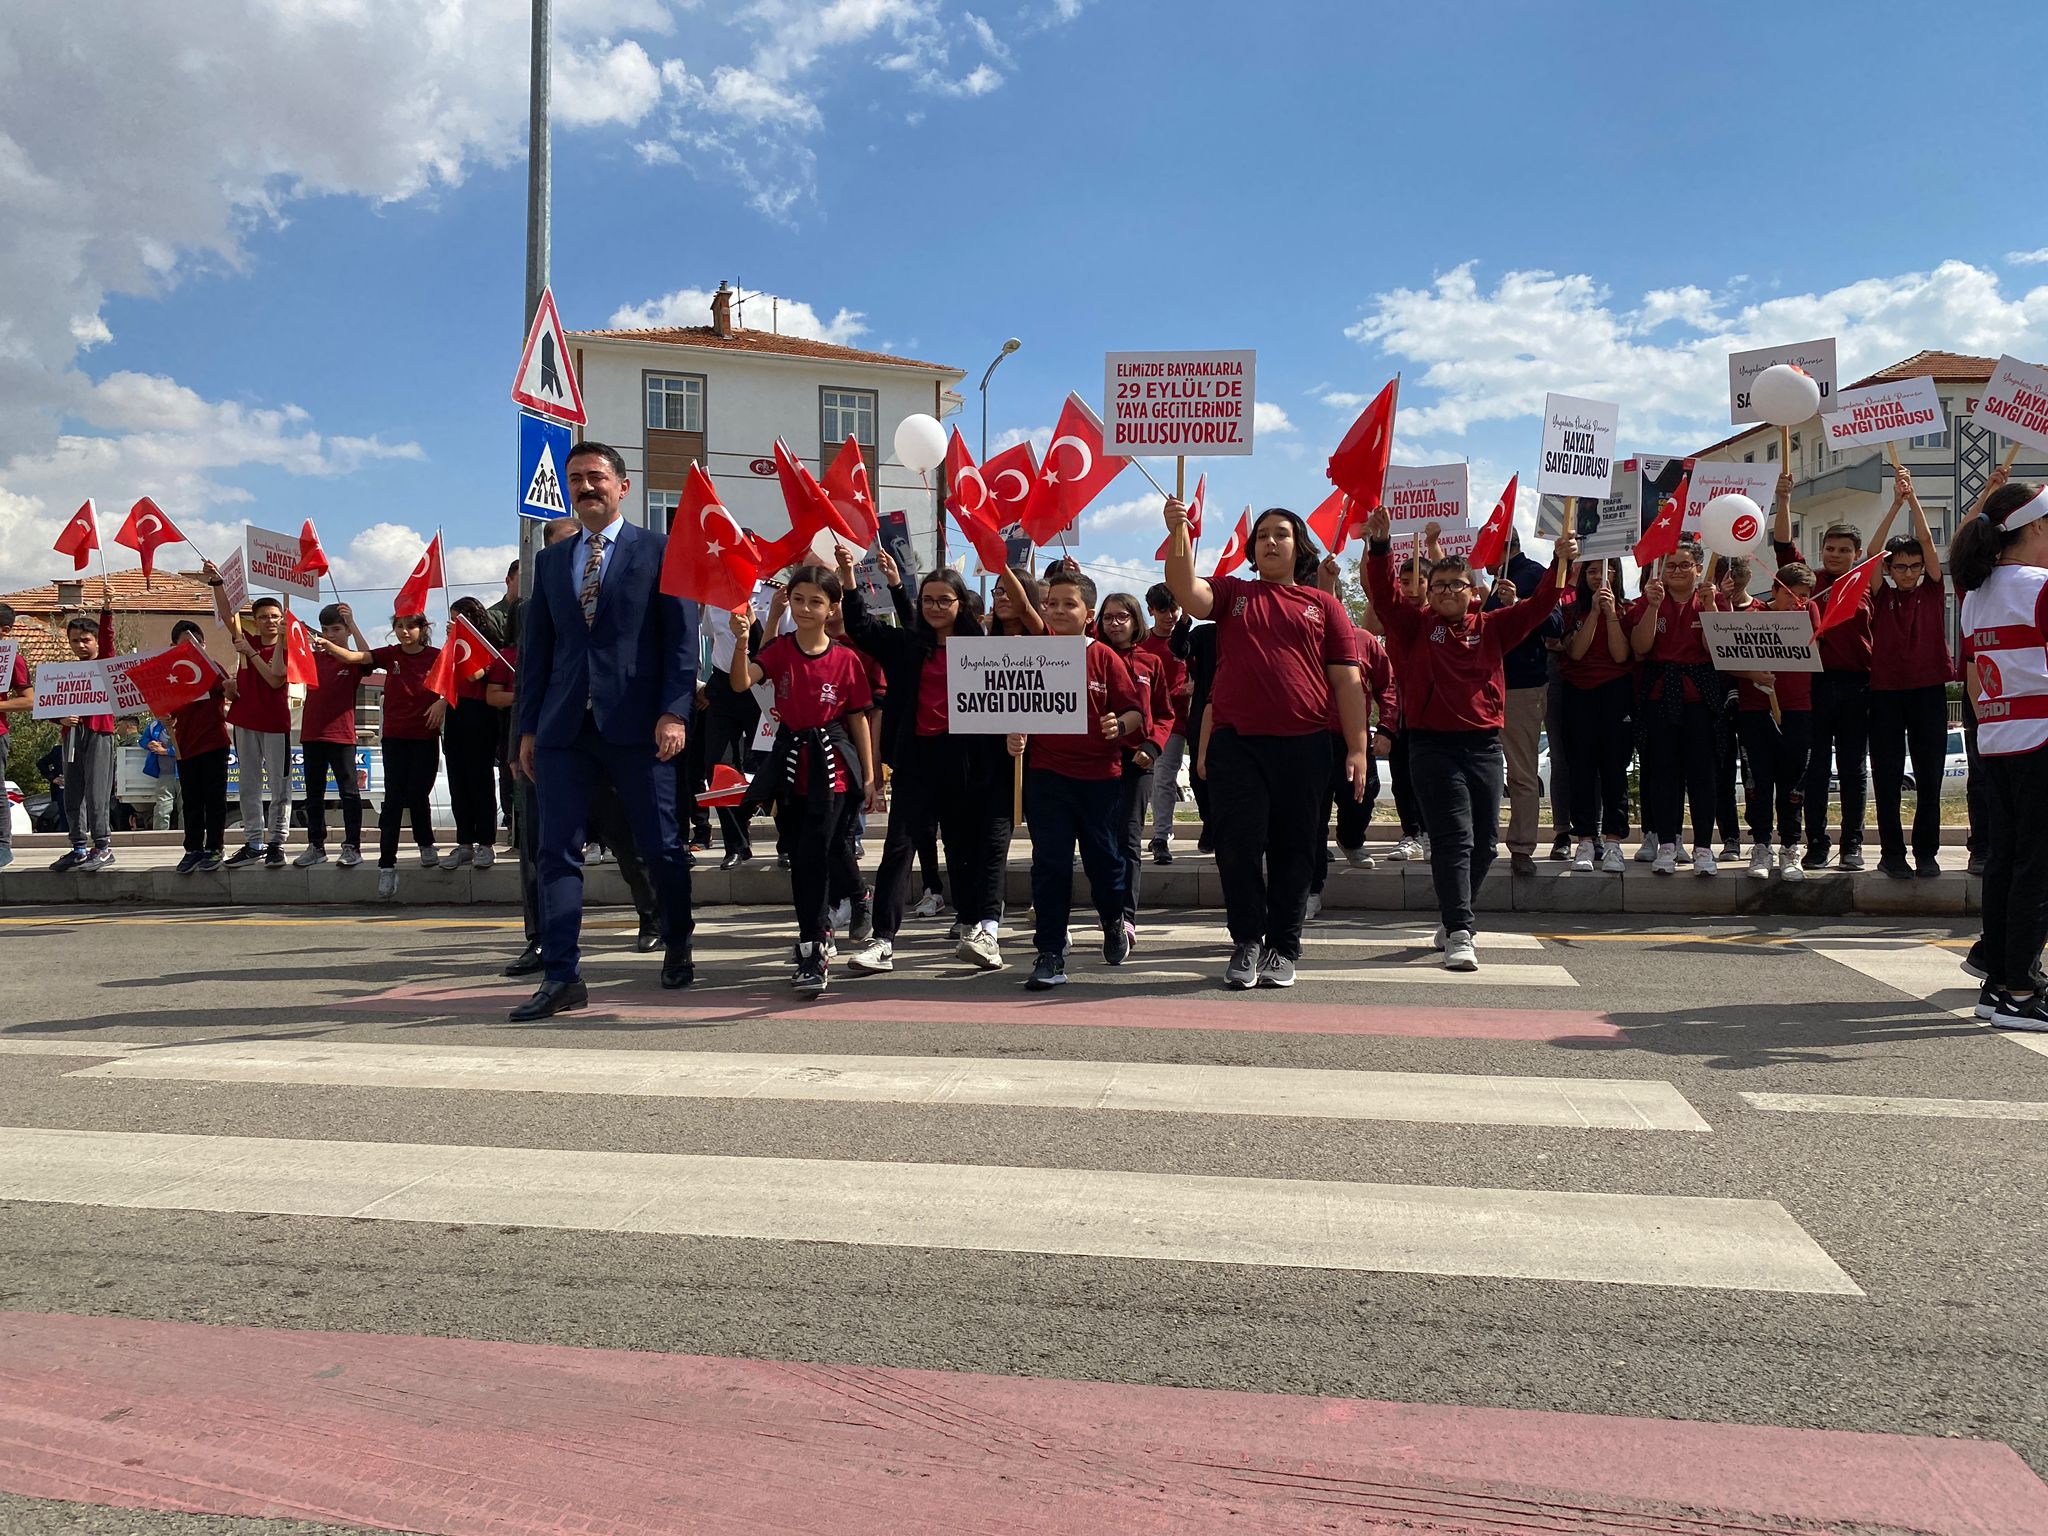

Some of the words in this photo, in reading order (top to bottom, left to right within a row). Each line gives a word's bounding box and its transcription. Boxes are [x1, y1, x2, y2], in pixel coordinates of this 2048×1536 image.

[1167, 361, 1243, 377] BAYRAKLARLA
[1117, 382, 1141, 399] 29
[1116, 402, 1148, 419] YAYA
[1852, 401, 1905, 421] HAYATA
[2012, 389, 2048, 417] HAYA
[1832, 418, 1873, 438] SAYGI
[1876, 408, 1935, 431] DURUŞU
[1984, 396, 2024, 424] SAYGI
[2021, 411, 2048, 435] DUR
[1115, 421, 1243, 445] BULUŞUYORUZ.
[1562, 431, 1595, 454] HAYATA
[1545, 450, 1572, 475] SAYGI
[1572, 454, 1609, 479] DURUŞU
[1393, 489, 1437, 505] HAYATA
[1389, 505, 1407, 520] YGI
[1409, 501, 1459, 517] DURUŞU
[251, 560, 277, 577] SAYGI
[266, 550, 297, 569] HAYATA
[1734, 632, 1783, 645] HAYATA
[1973, 631, 2000, 647] KUL
[1716, 645, 1754, 659] SAYGI
[1756, 645, 1811, 660] DURUŞU
[56, 679, 92, 693] HAYATA
[111, 671, 127, 685] 29
[984, 670, 1045, 691] HAYATA
[38, 693, 68, 707] SAYGI
[68, 691, 108, 705] DURUŞU
[956, 692, 1005, 713] SAYGI
[1007, 692, 1078, 714] DURUŞU
